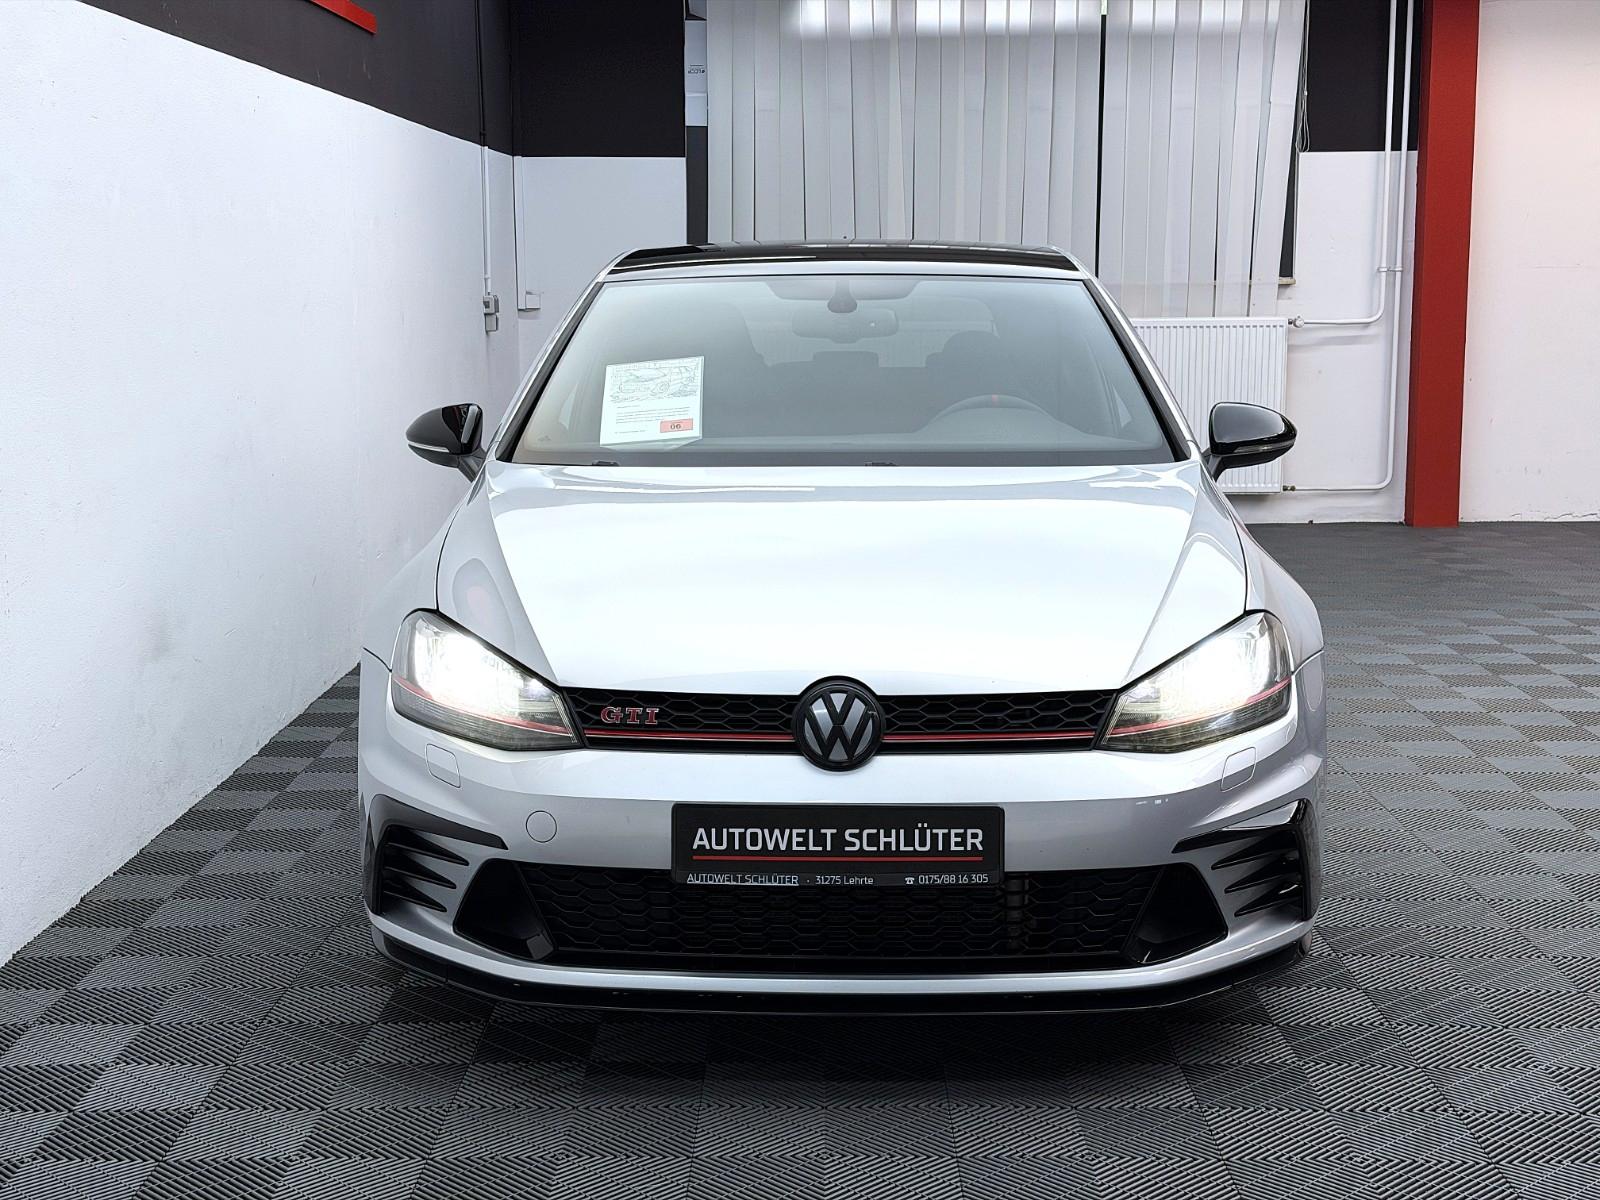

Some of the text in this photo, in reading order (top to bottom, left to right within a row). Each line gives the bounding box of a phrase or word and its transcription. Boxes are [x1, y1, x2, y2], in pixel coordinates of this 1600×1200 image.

[600, 706, 660, 725] GTI
[692, 822, 984, 852] AUTOWELT SCHLÜTER
[687, 873, 989, 886] AUTOWELT SCHLÜTER 31275 Lehrte 0175/88 16 305
